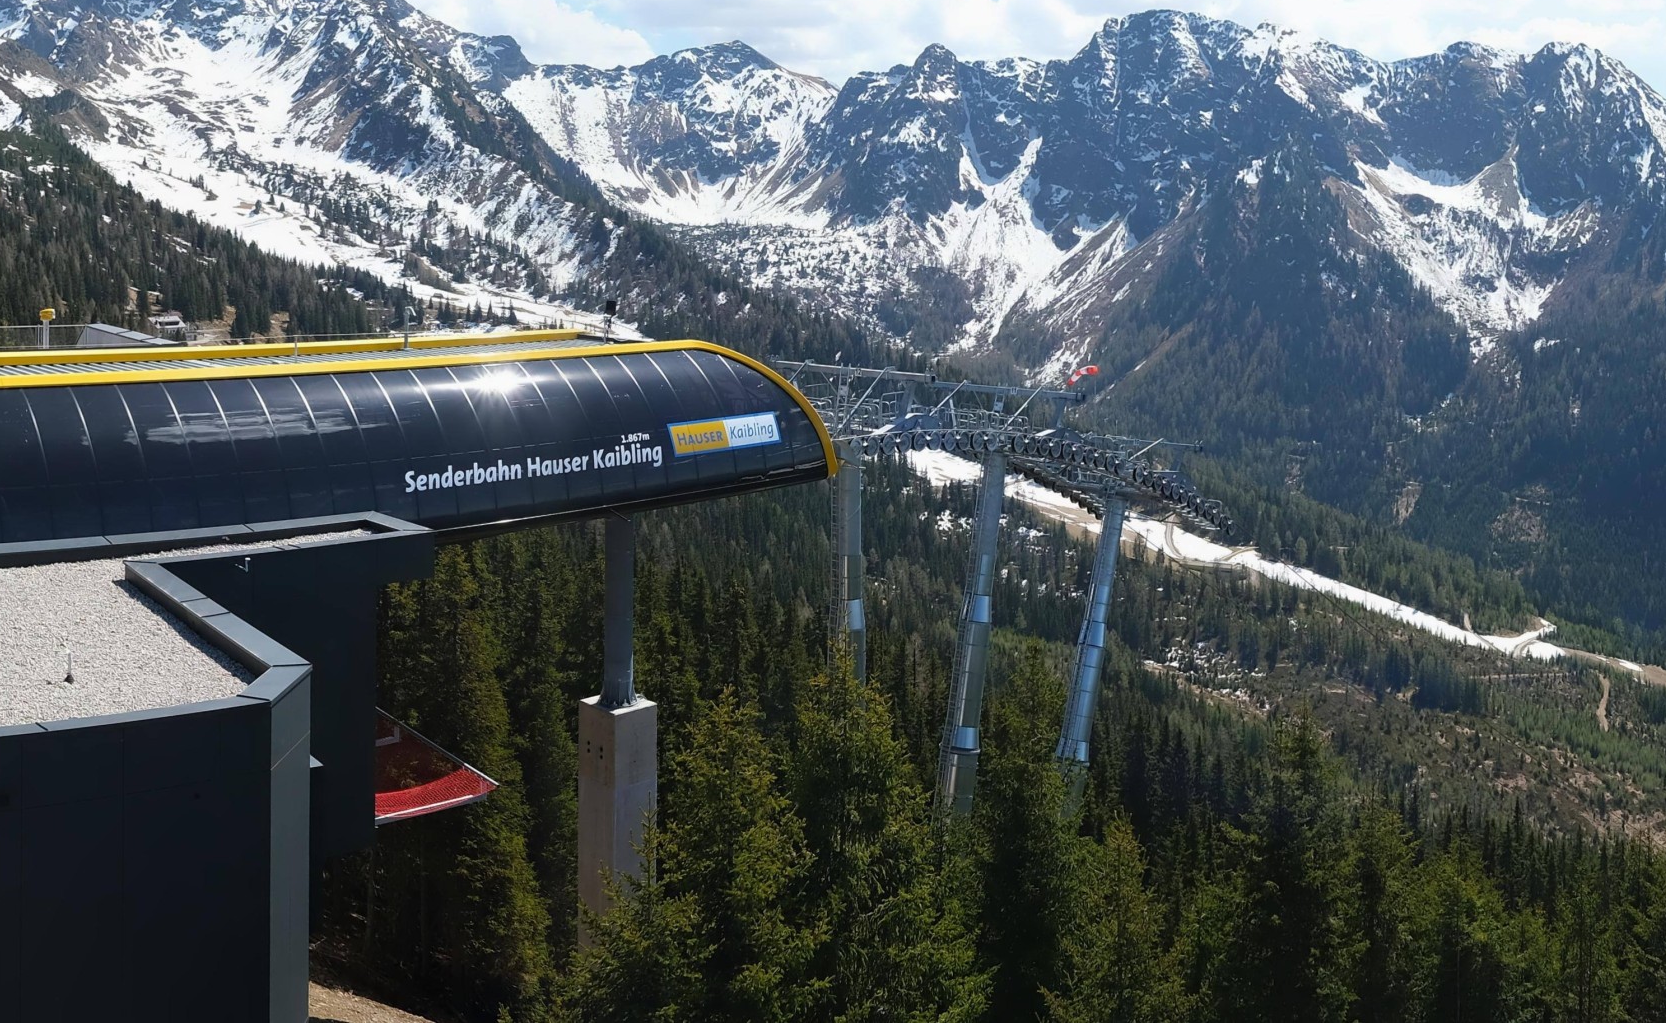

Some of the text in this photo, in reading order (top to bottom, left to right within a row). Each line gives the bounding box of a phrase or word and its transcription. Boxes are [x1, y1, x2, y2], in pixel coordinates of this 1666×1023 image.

[621, 432, 650, 443] 1.867m
[676, 422, 774, 447] HAUSER Kaibling
[405, 443, 663, 493] Senderbahn Hauser Kaibling
